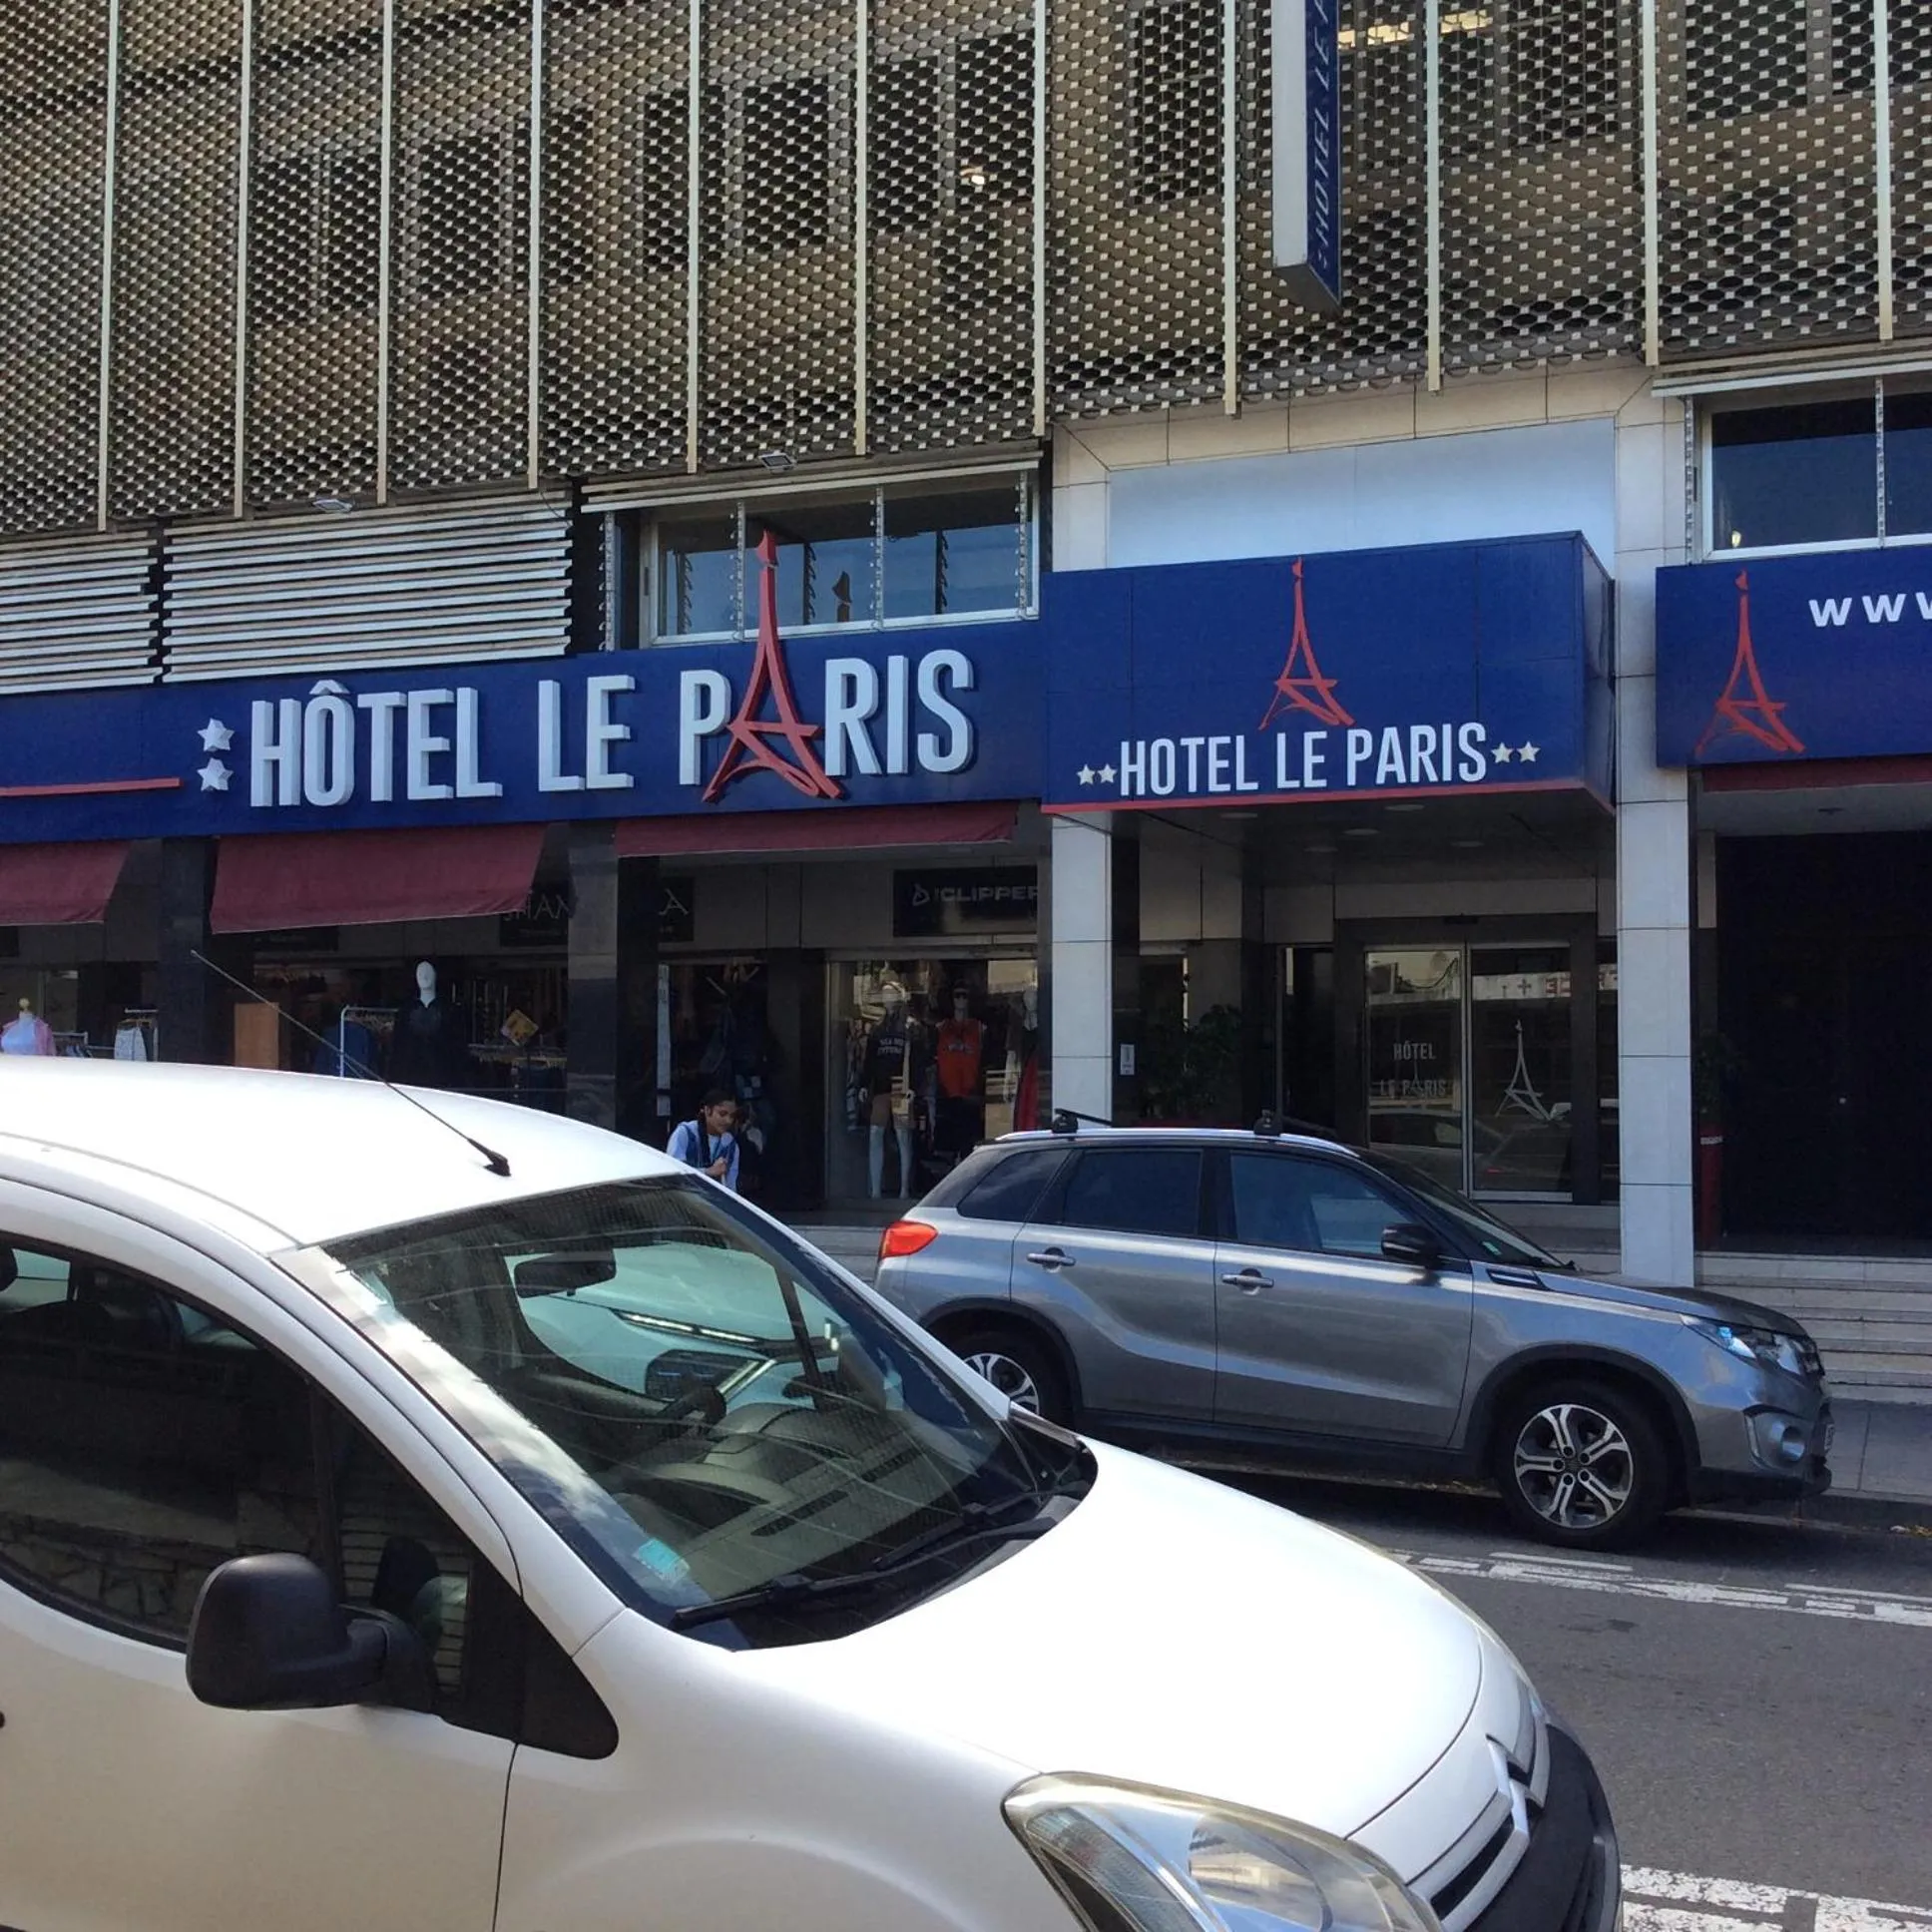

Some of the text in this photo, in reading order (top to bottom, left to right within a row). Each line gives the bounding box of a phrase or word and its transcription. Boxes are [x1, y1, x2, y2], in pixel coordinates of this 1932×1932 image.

[1314, 26, 1330, 92] LE
[1314, 107, 1330, 246] HOTEL
[250, 680, 503, 807] HÔTEL
[538, 675, 636, 792] LE
[1120, 722, 1487, 797] HOTEL LE PARIS
